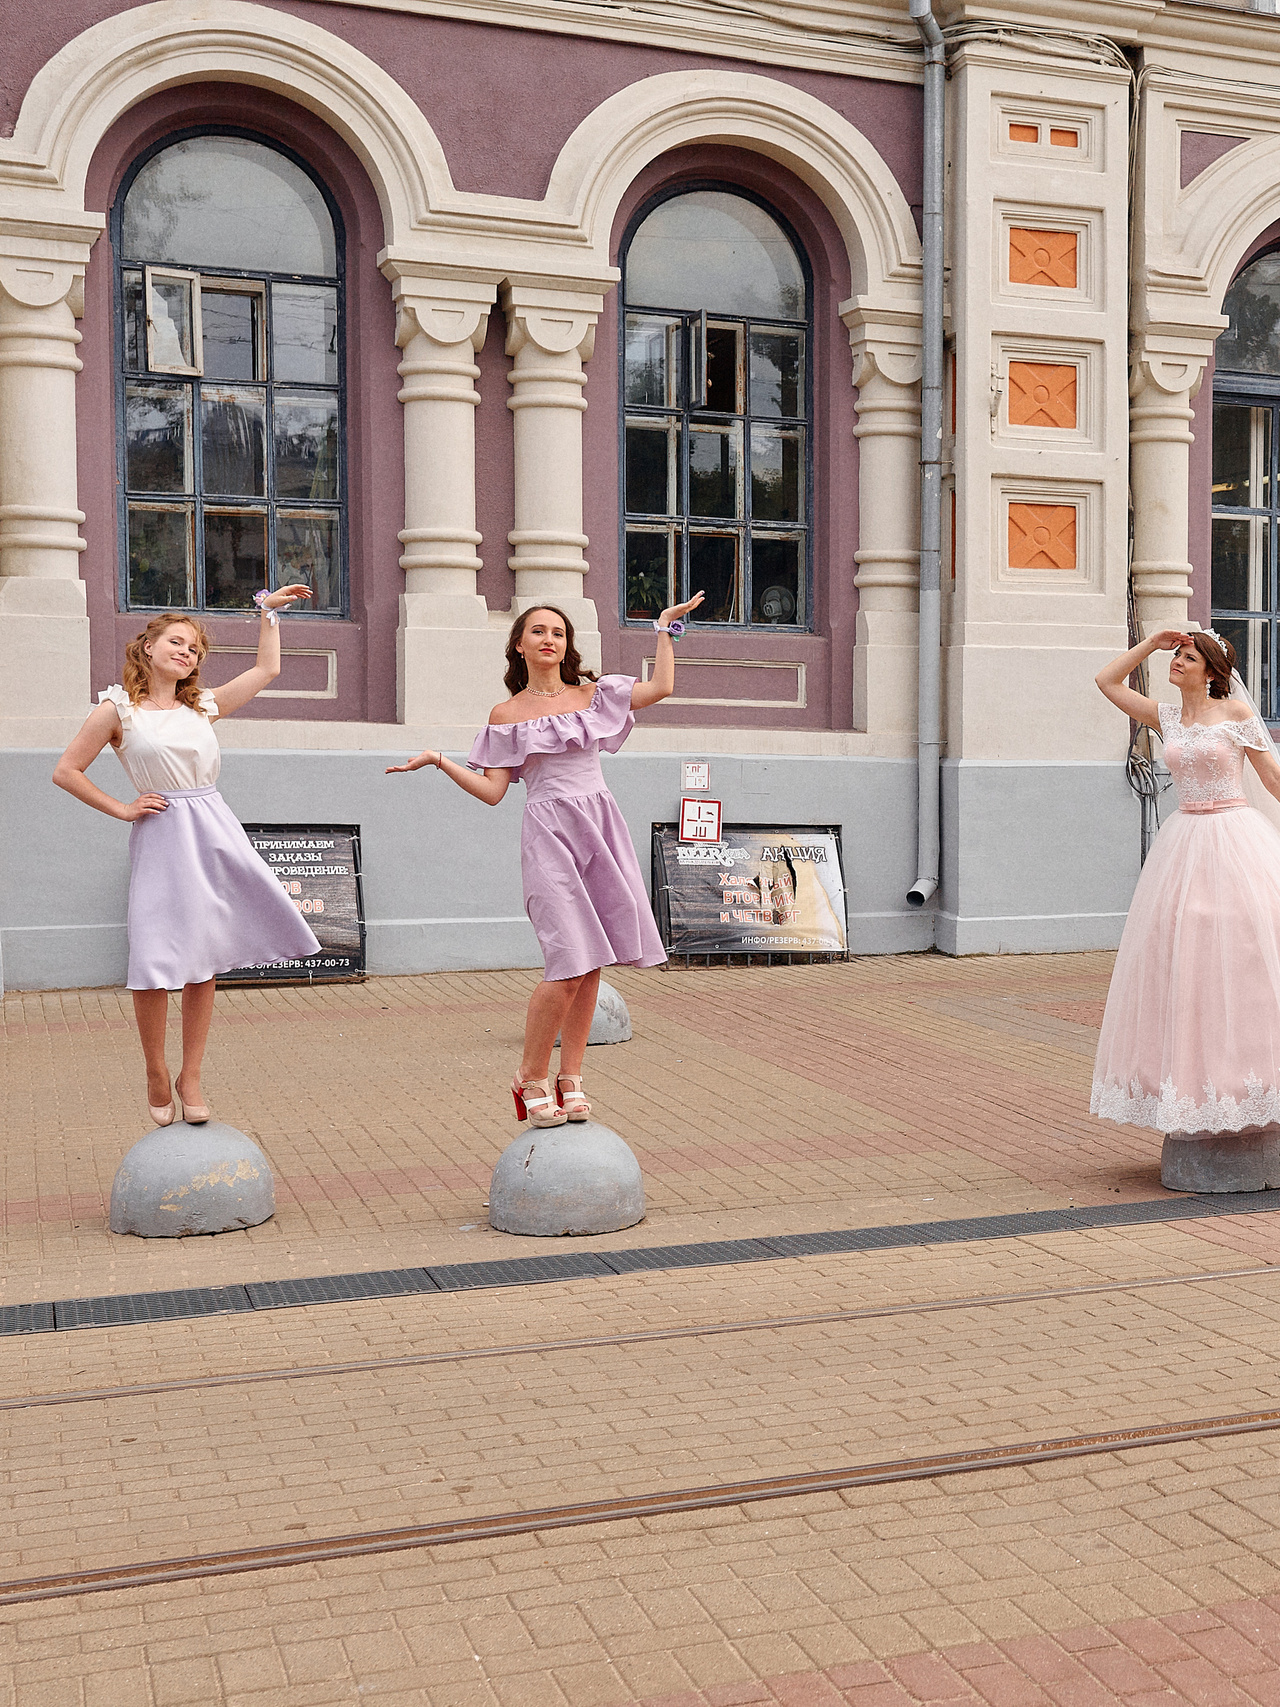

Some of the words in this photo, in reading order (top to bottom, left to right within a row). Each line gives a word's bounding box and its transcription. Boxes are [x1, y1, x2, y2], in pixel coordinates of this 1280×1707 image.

[253, 840, 335, 850] ПРИНИМАЕМ
[268, 852, 323, 863] ЗАКАЗЫ
[760, 846, 828, 863] АКЦИЯ
[723, 890, 794, 908] ВТОРНИК
[741, 936, 801, 945] ИНФО/РЕЗЕРВ:
[305, 958, 350, 968] 437-00-73
